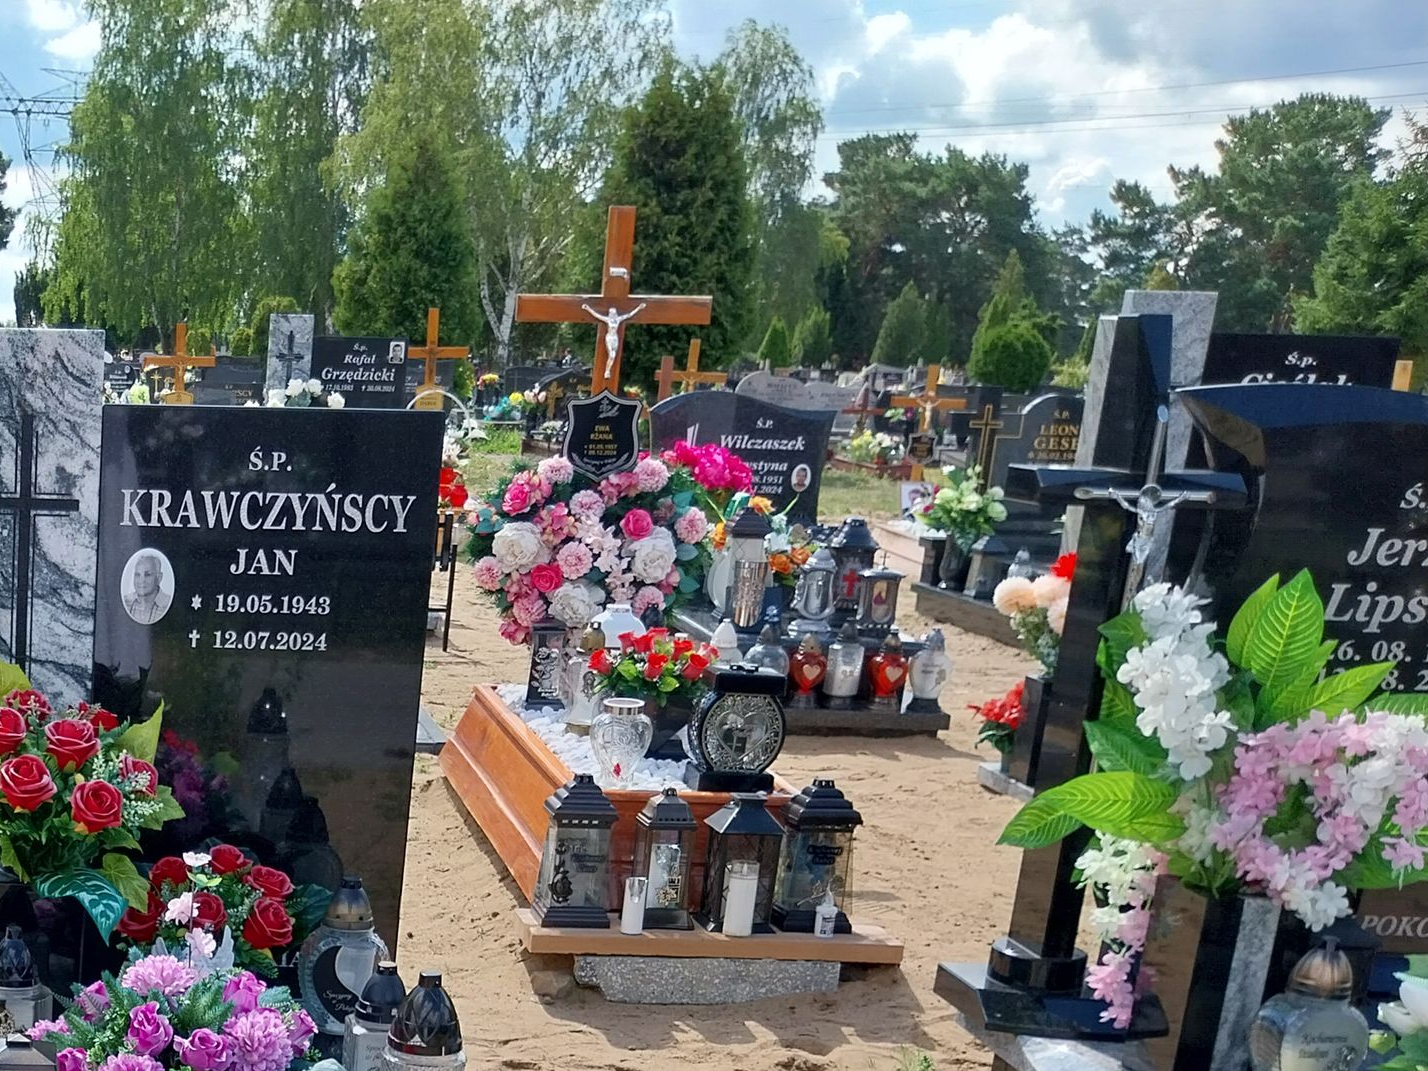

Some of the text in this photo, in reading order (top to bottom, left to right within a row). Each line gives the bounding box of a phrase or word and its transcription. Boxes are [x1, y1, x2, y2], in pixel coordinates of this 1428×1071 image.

[321, 367, 396, 382] Grzędzicki
[720, 434, 806, 451] Wilczaszek
[248, 447, 293, 473] Ś.P.
[119, 483, 417, 534] KRAWCZYŃSCY
[229, 549, 298, 577] JAN
[215, 594, 331, 615] 19.05.1943
[212, 630, 328, 651] 12.07.2024
[1380, 669, 1405, 690] 8.
